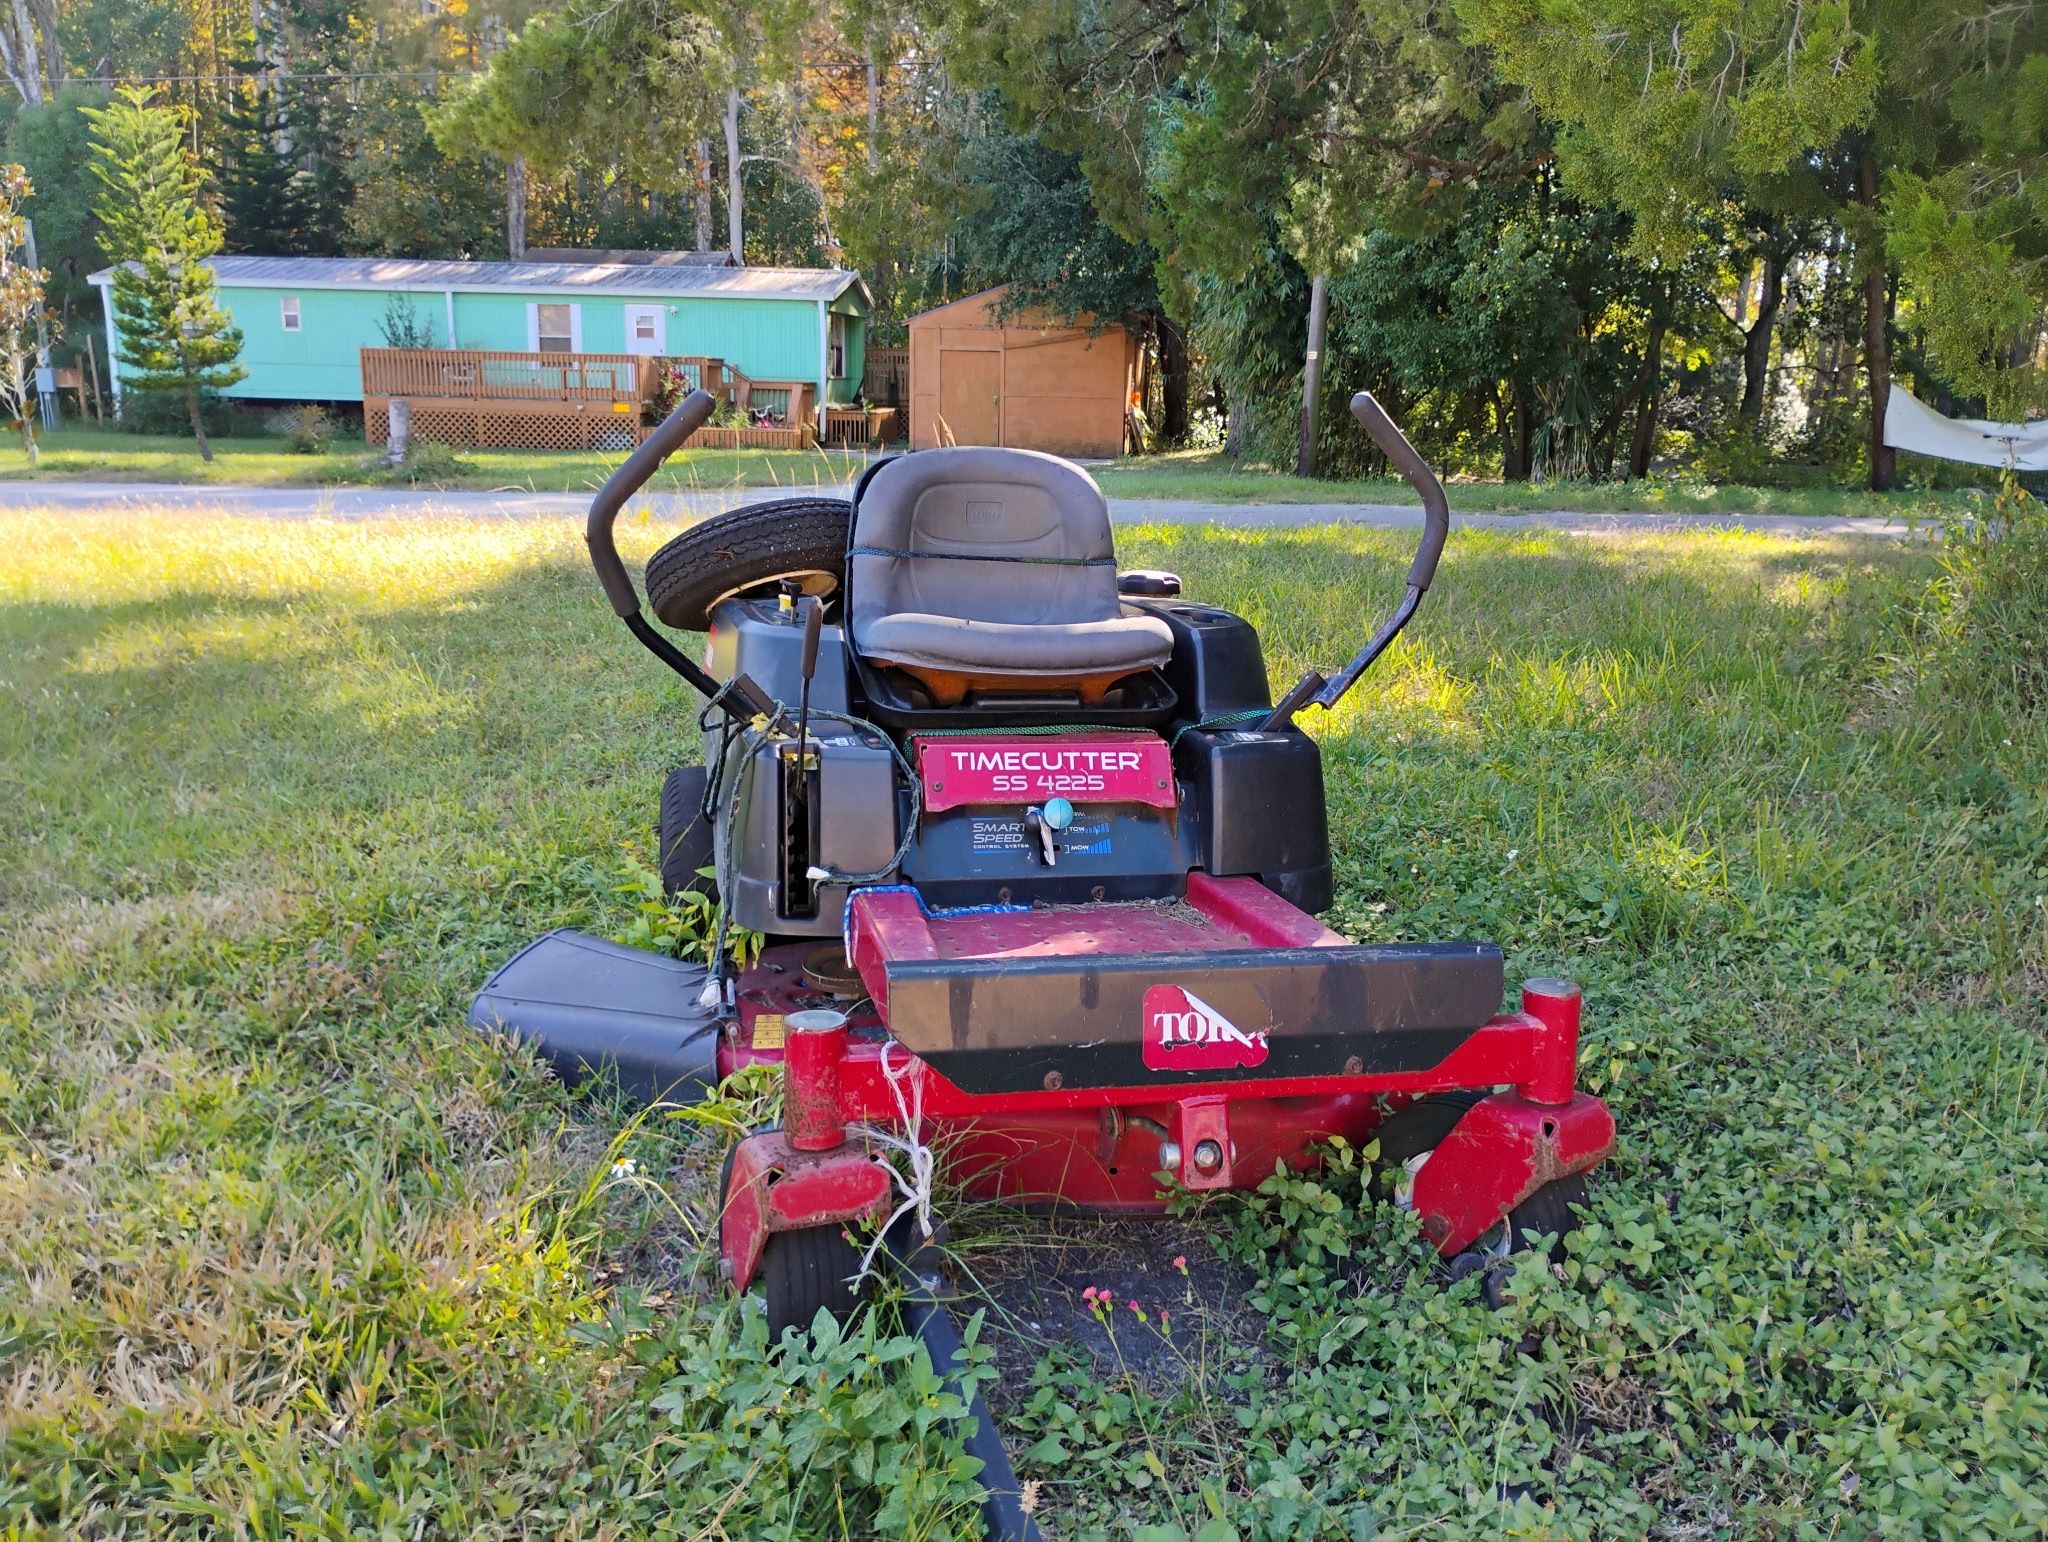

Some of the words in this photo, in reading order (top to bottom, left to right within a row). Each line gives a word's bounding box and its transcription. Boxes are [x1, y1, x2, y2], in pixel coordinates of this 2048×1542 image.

[951, 752, 1140, 770] TIMECUTTER
[992, 775, 1028, 791] SS
[1036, 775, 1105, 791] 4225
[973, 833, 1023, 844] SPEED
